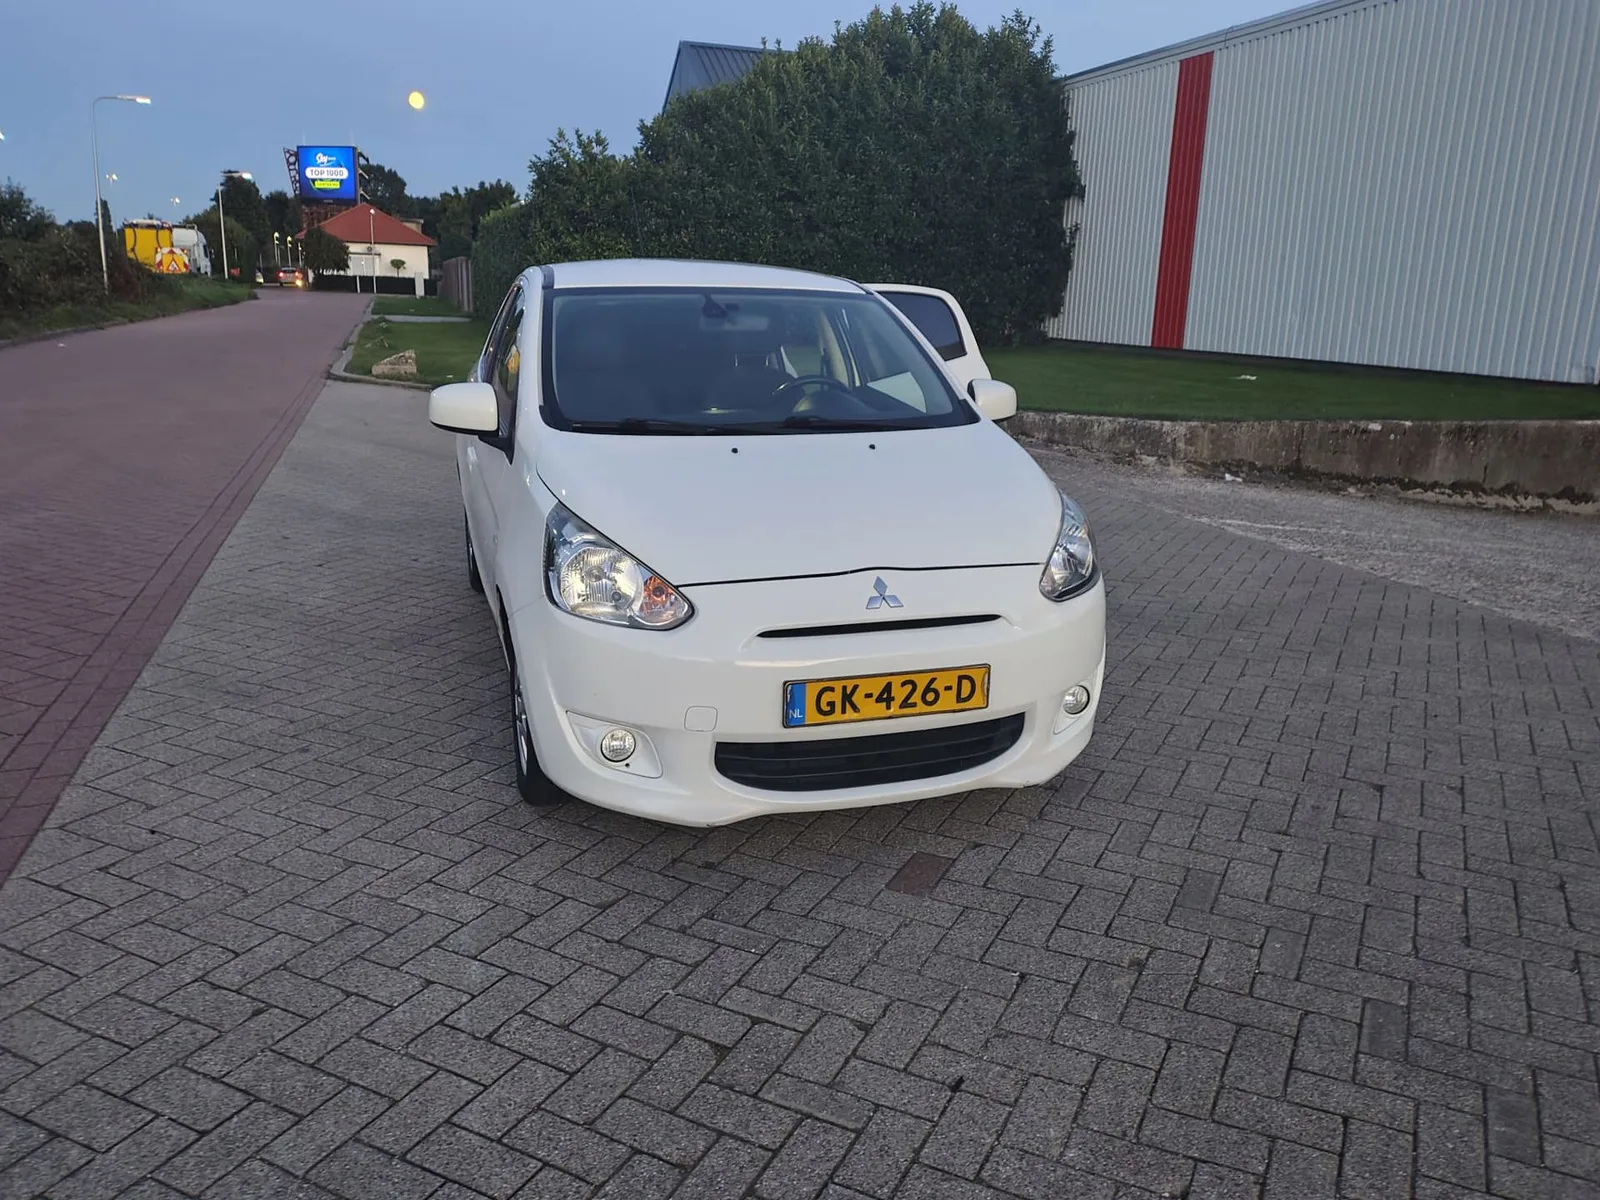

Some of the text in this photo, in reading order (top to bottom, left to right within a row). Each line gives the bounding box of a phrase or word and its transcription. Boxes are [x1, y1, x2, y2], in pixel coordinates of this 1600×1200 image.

[310, 169, 344, 177] TOP 1000
[815, 674, 976, 717] GK-426-D
[789, 708, 803, 719] NL
